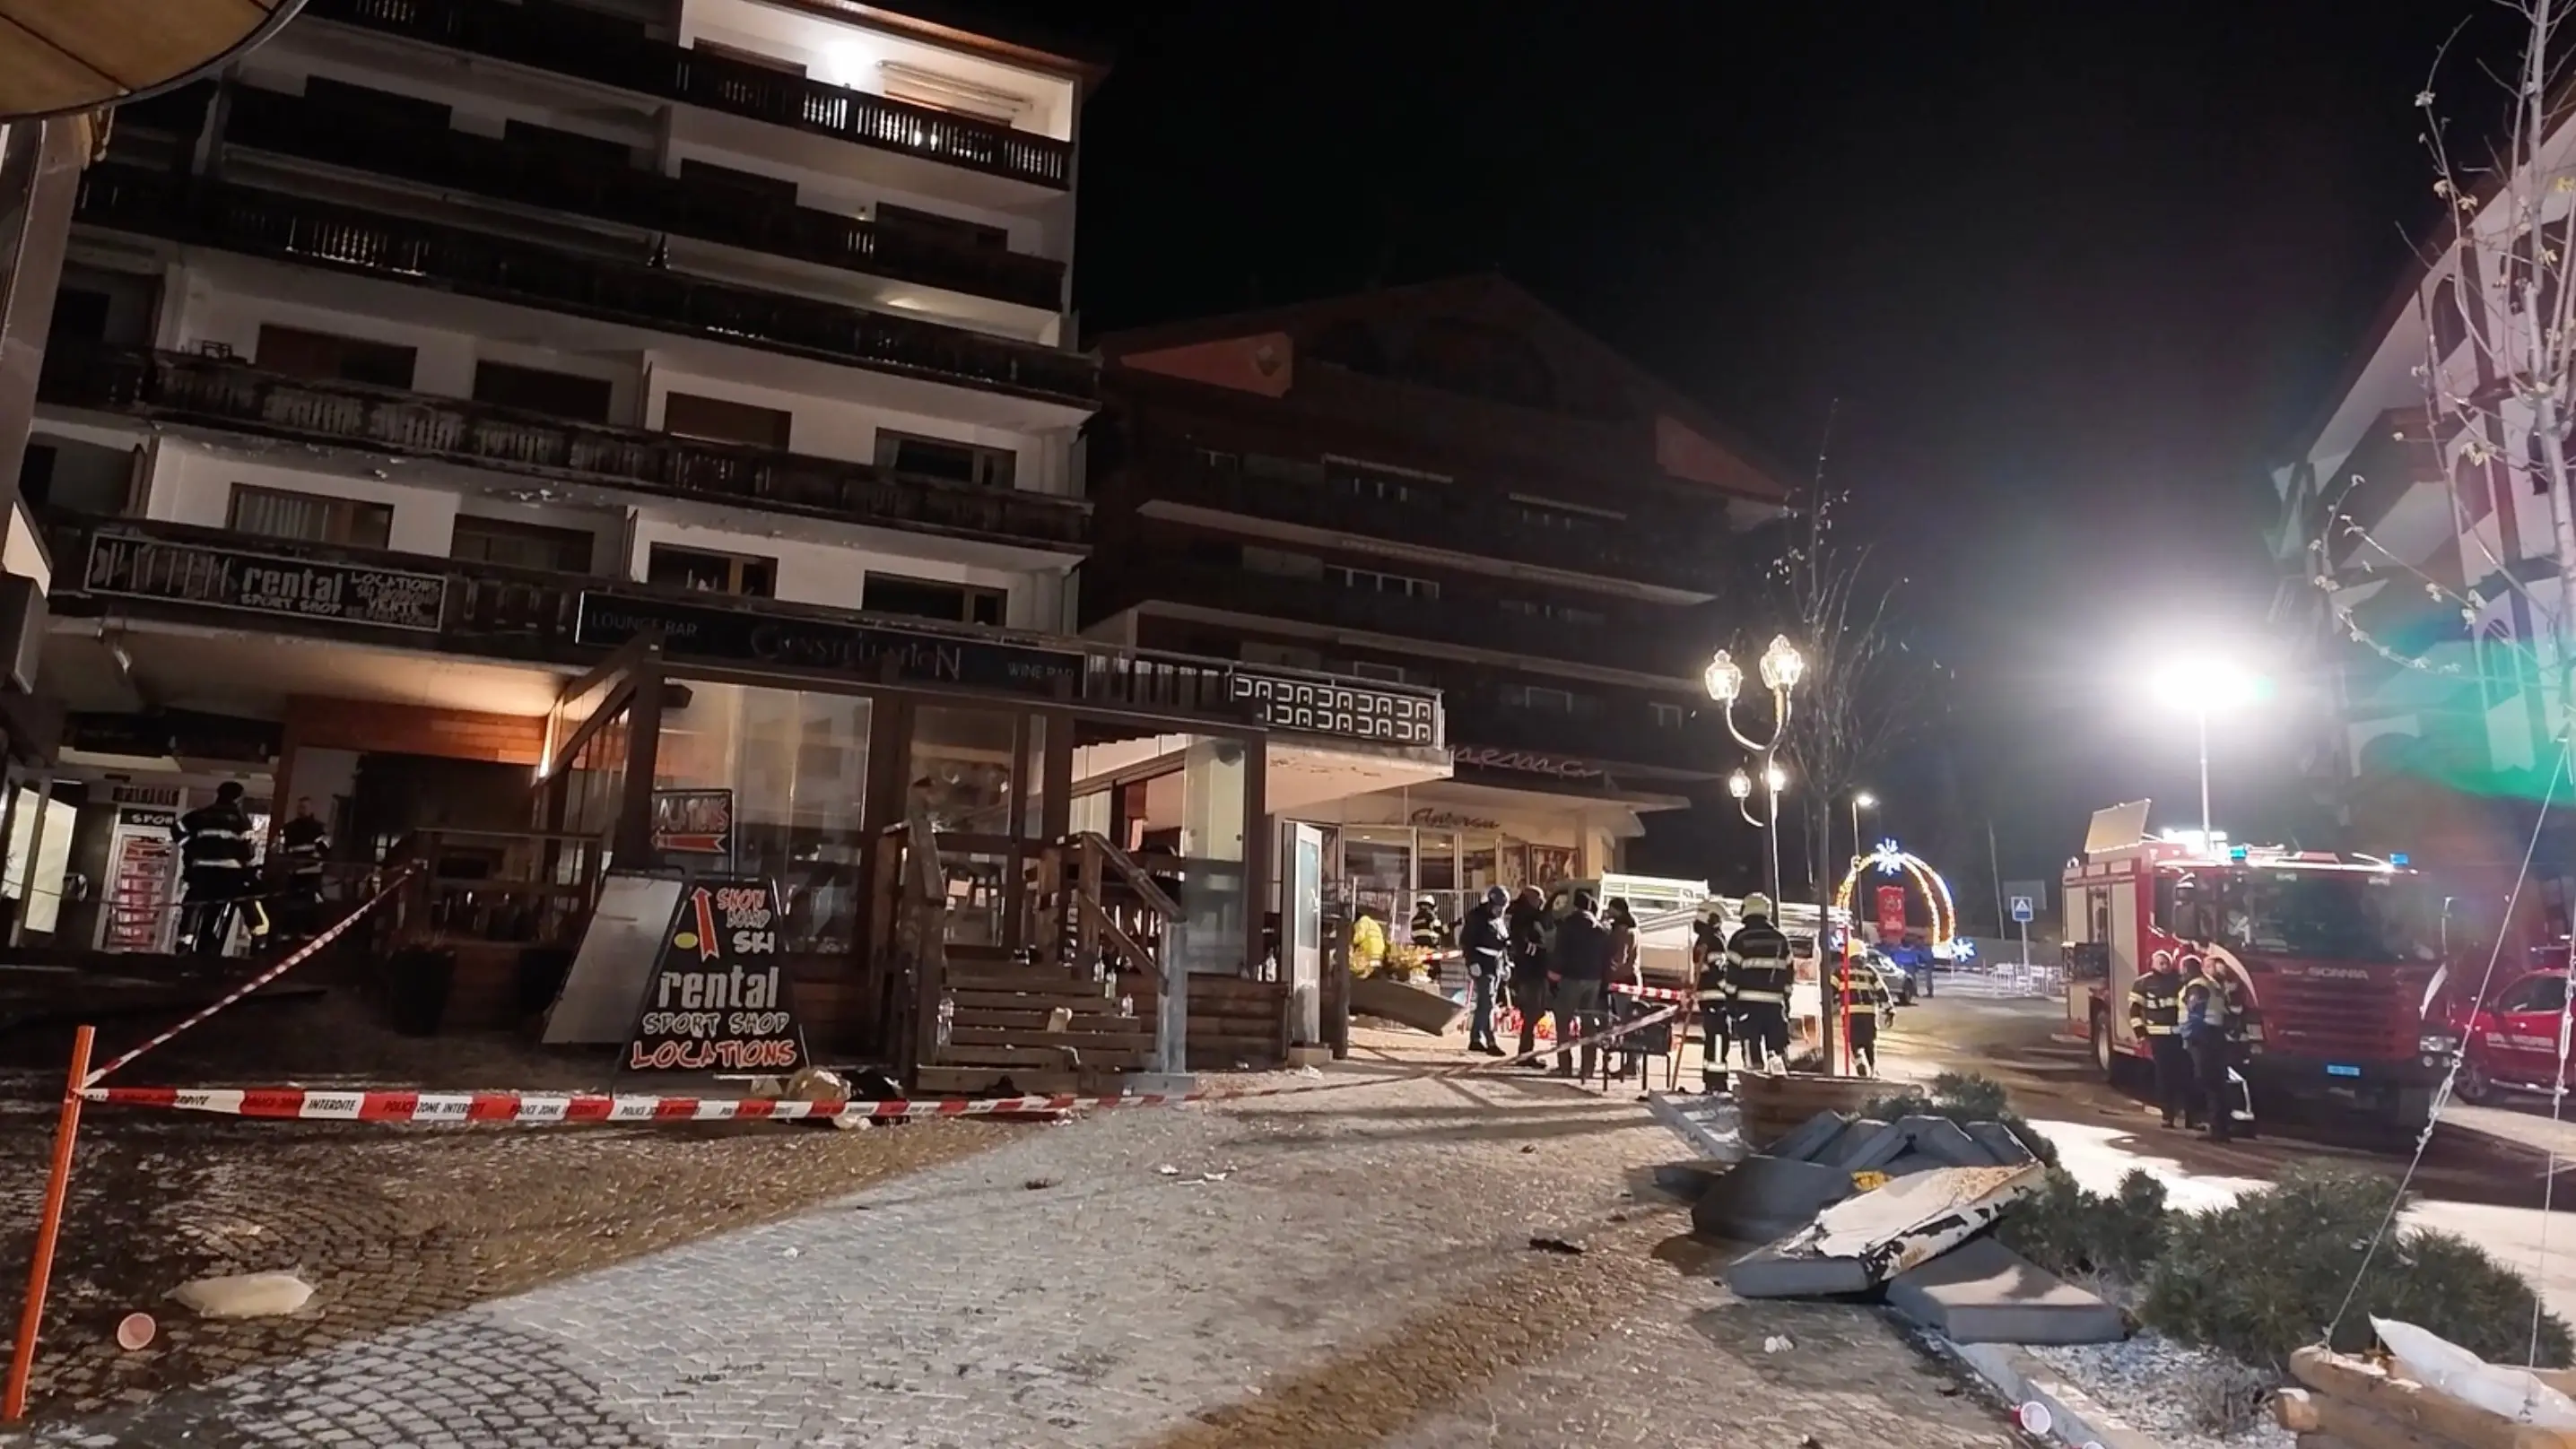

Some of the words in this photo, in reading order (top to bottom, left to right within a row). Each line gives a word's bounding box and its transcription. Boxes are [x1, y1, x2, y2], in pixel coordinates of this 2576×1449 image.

[241, 567, 344, 603] rental
[240, 594, 294, 611] SPORT
[299, 600, 342, 615] SHOP
[591, 611, 659, 630] LOUNGE
[665, 621, 698, 637] BAR
[1007, 662, 1042, 679] WINE
[732, 930, 776, 954] SKI
[657, 964, 779, 1010] rental
[642, 1011, 722, 1039] SPORT
[727, 1011, 791, 1036] SHOP
[630, 1039, 797, 1071] LOCATIONS
[308, 1098, 357, 1112] INTERDITE
[417, 1100, 441, 1114] ZONE
